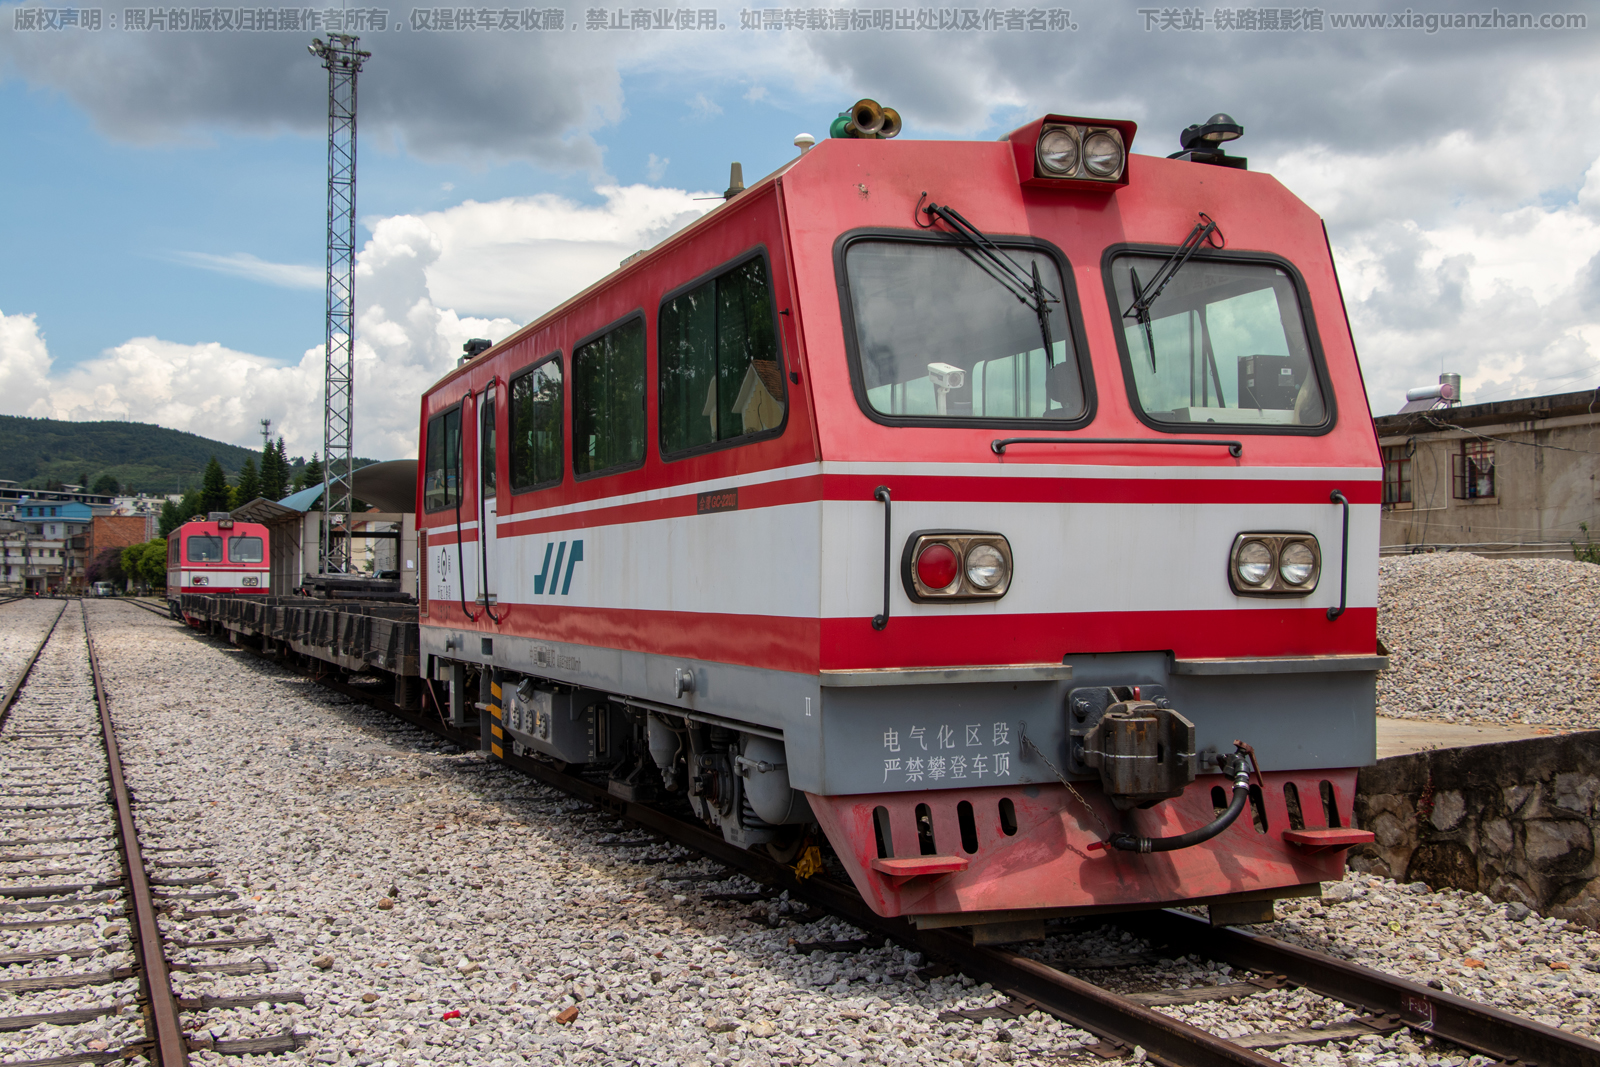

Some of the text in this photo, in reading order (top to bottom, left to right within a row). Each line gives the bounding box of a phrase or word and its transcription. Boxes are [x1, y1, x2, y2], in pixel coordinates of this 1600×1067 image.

[883, 722, 1010, 752] 电气化区段
[883, 752, 1011, 783] 严禁攀登车顶
